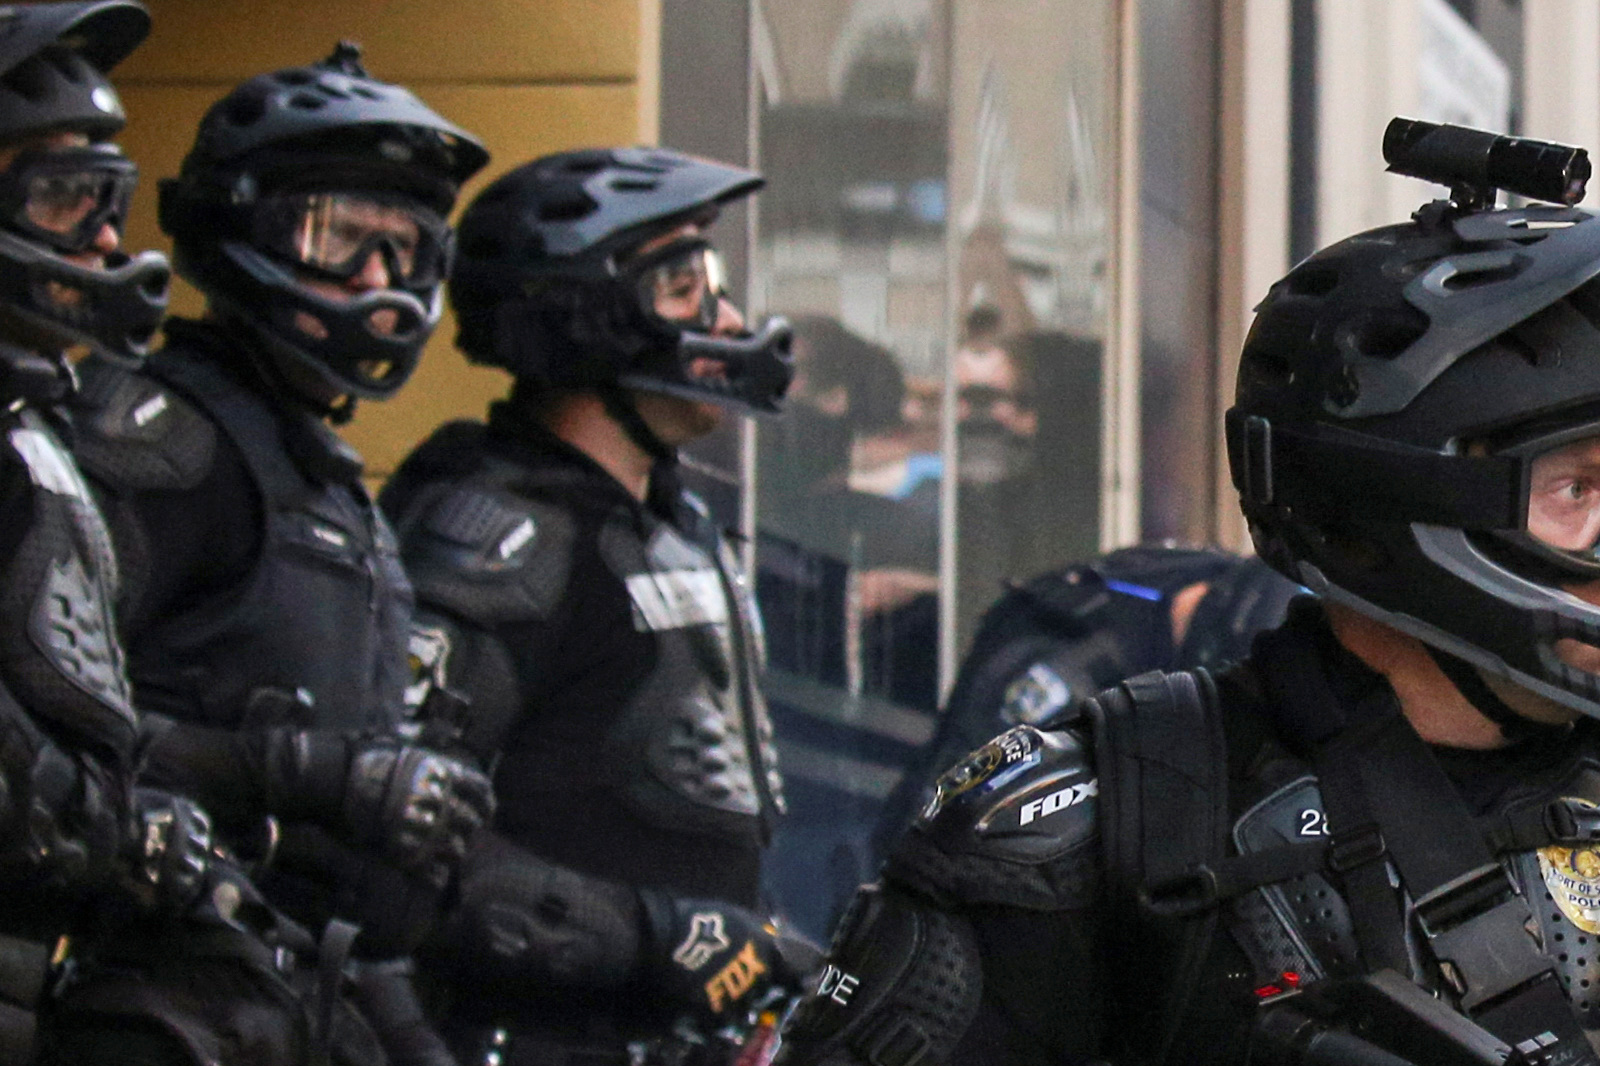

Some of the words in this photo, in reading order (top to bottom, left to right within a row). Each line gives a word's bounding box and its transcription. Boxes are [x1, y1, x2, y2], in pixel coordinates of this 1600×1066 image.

[1018, 778, 1100, 827] FOX
[1577, 882, 1593, 895] OF
[704, 941, 767, 1014] FOX
